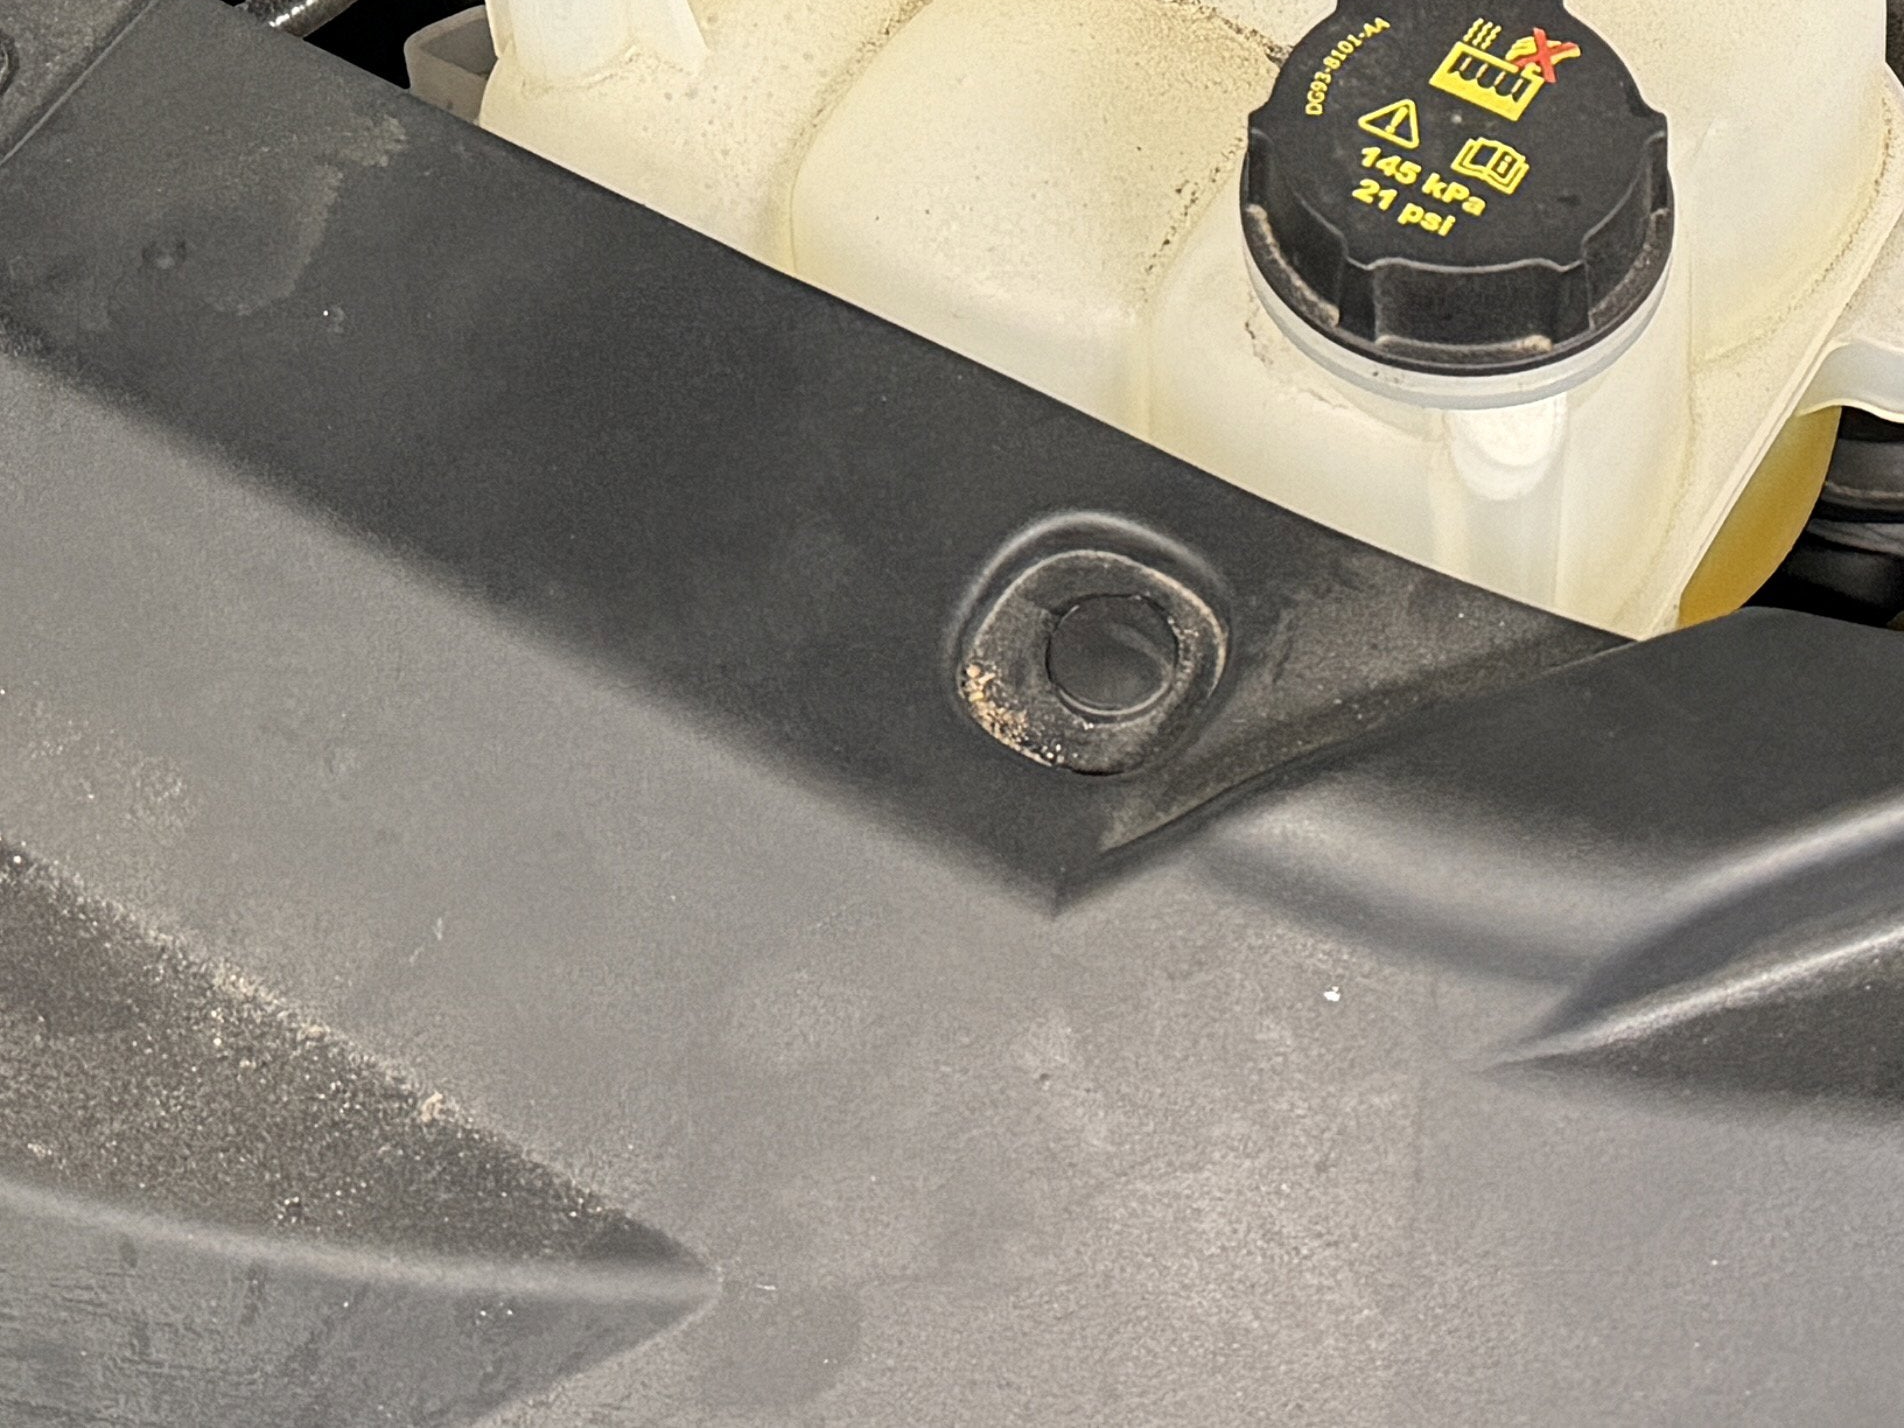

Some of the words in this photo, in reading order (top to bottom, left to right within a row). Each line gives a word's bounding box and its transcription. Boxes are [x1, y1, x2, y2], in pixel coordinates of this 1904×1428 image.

[1305, 16, 1391, 116] DG93-8101-AA
[1352, 178, 1398, 211] 21
[1397, 202, 1456, 237] psi
[1361, 146, 1422, 184] 145
[1421, 172, 1486, 217] kPa
